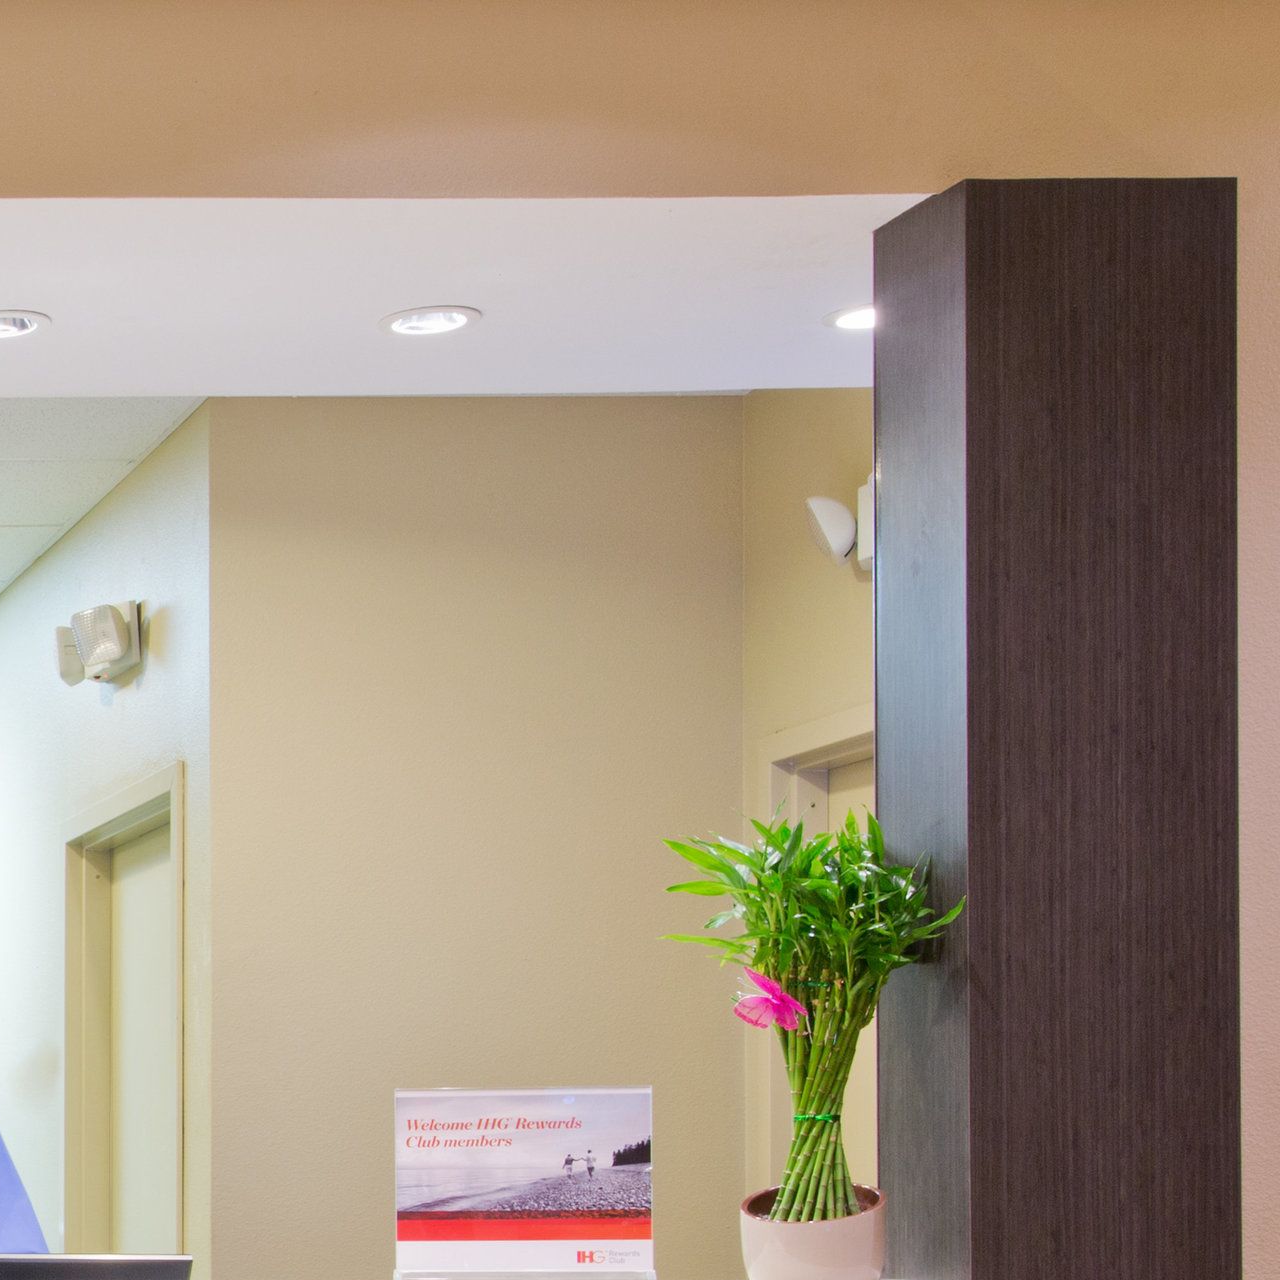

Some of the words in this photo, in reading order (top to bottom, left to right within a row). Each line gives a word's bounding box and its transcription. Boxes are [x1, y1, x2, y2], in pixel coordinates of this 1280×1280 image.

[406, 1119, 472, 1132] Welcome
[476, 1118, 509, 1131] IHG
[515, 1117, 582, 1130] Rewards
[405, 1135, 440, 1148] Club
[443, 1135, 513, 1148] members
[576, 1250, 606, 1264] IHG
[608, 1249, 641, 1257] Rewards
